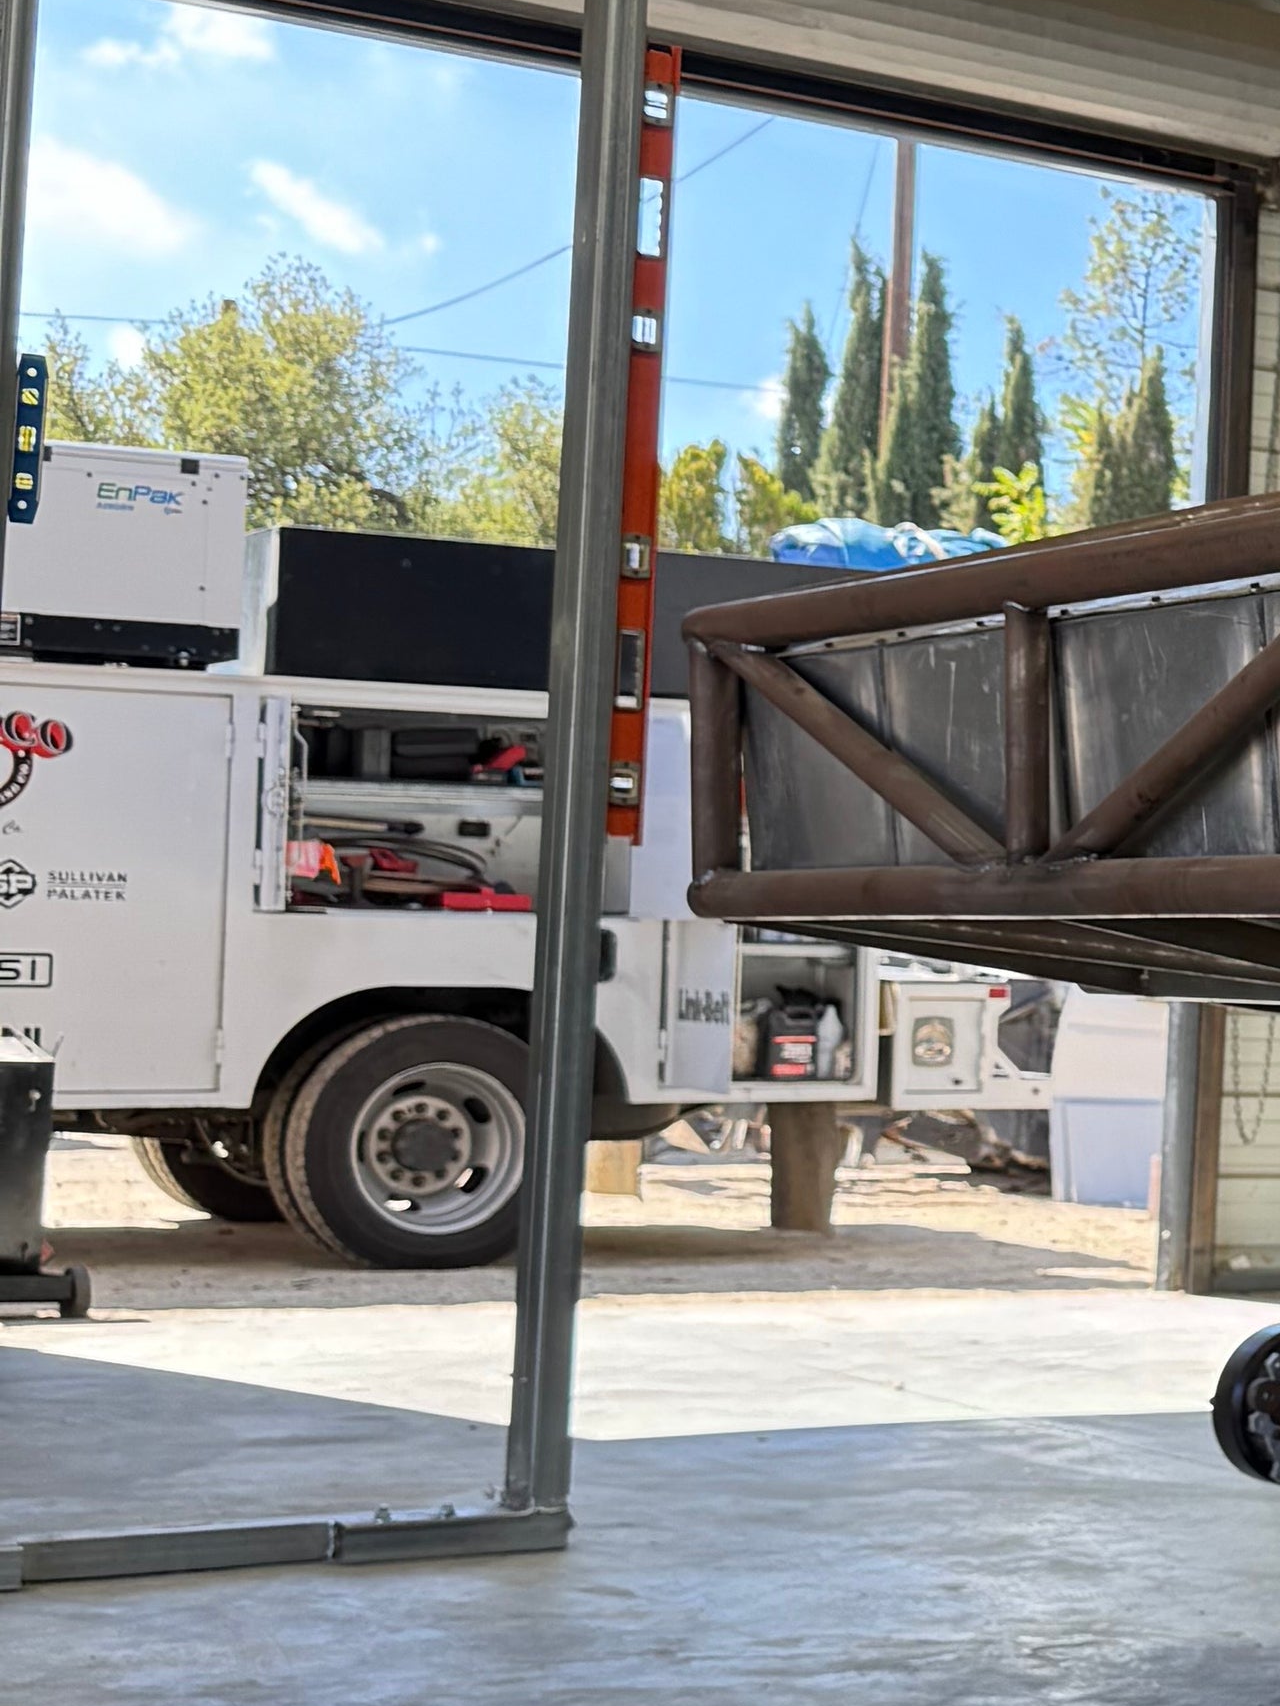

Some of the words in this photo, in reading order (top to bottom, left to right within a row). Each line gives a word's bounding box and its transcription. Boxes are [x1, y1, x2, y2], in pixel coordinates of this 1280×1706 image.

[97, 482, 183, 505] EnPak
[48, 871, 127, 883] SULLIVAN
[47, 889, 126, 901] PALATEK
